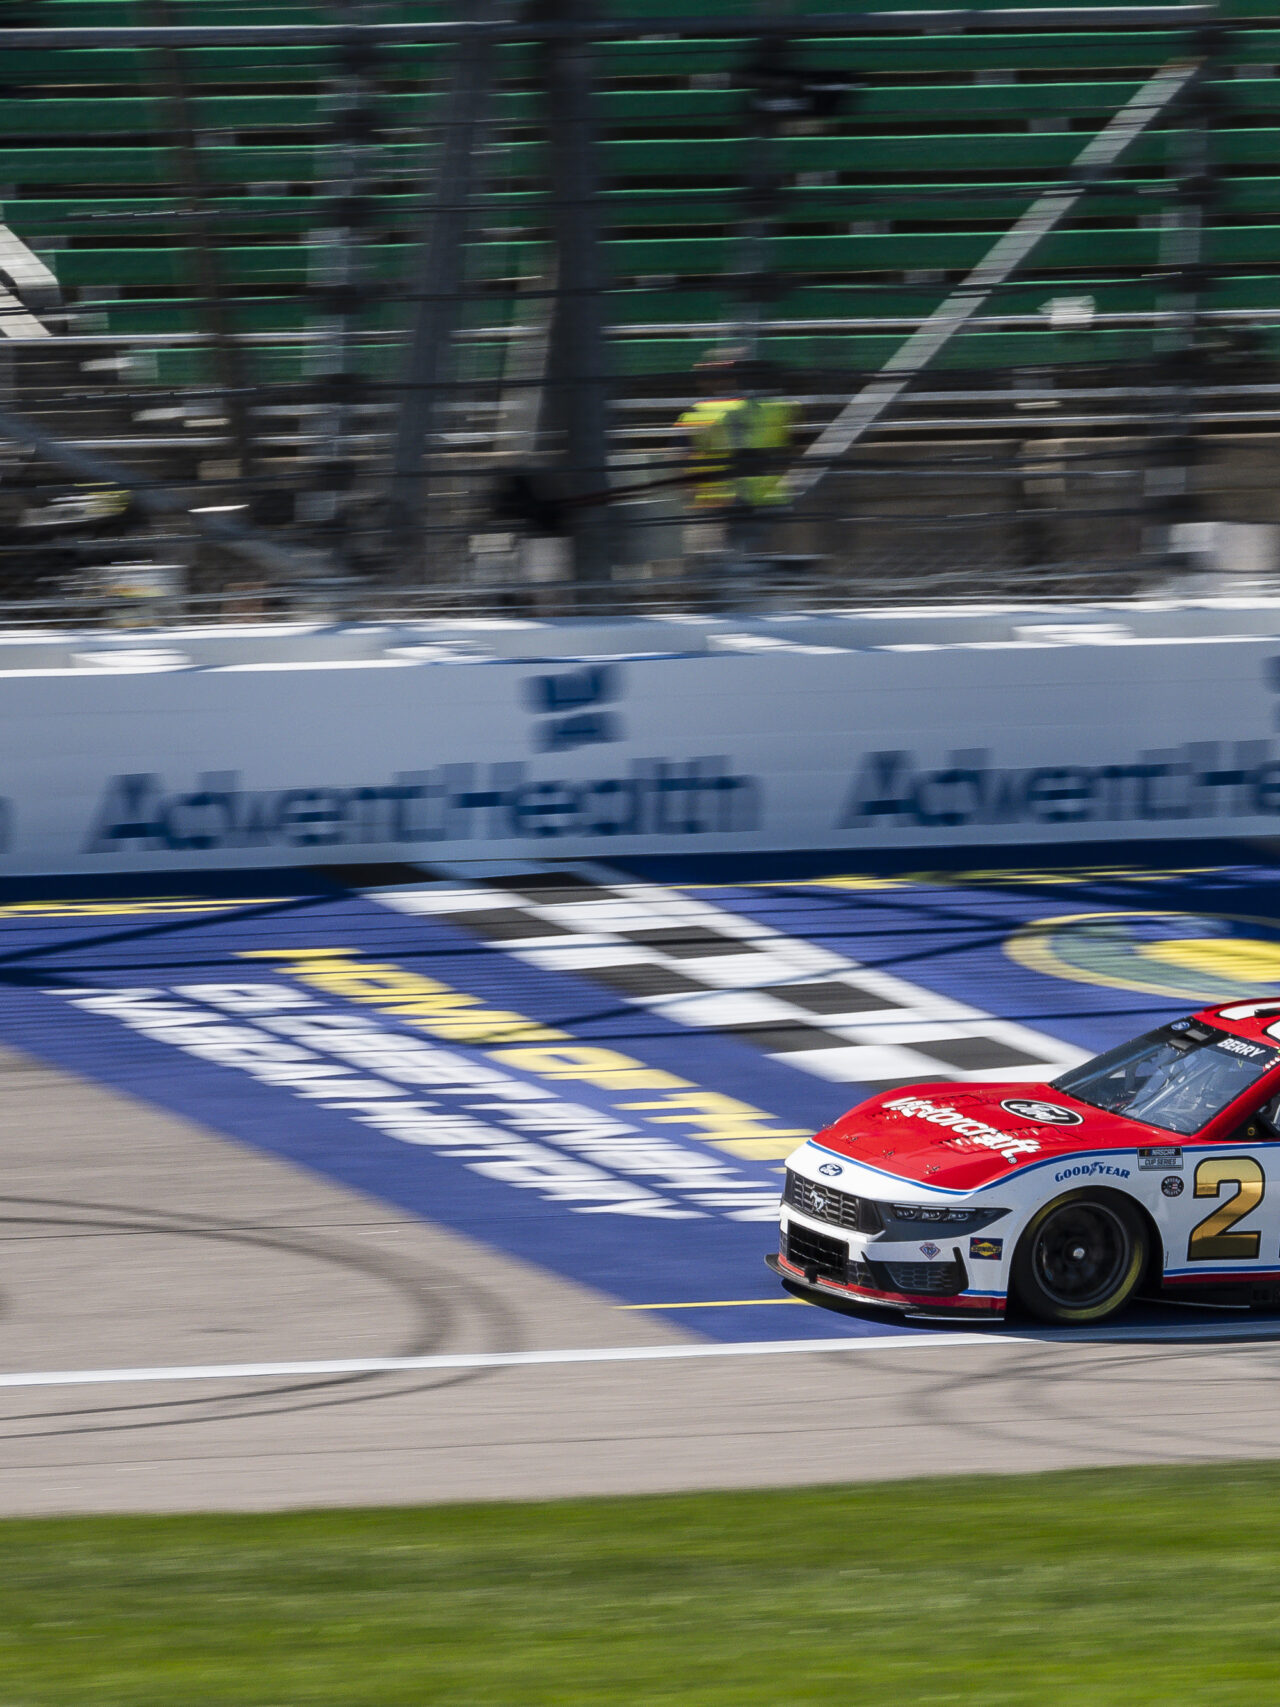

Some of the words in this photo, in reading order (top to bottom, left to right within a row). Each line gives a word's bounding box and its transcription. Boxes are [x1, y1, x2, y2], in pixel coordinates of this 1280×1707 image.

[81, 755, 765, 854] AdventHealth
[1217, 1038, 1266, 1058] BERRY
[882, 1096, 1041, 1160] Motorcraft
[1055, 1162, 1130, 1182] GOODYEAR
